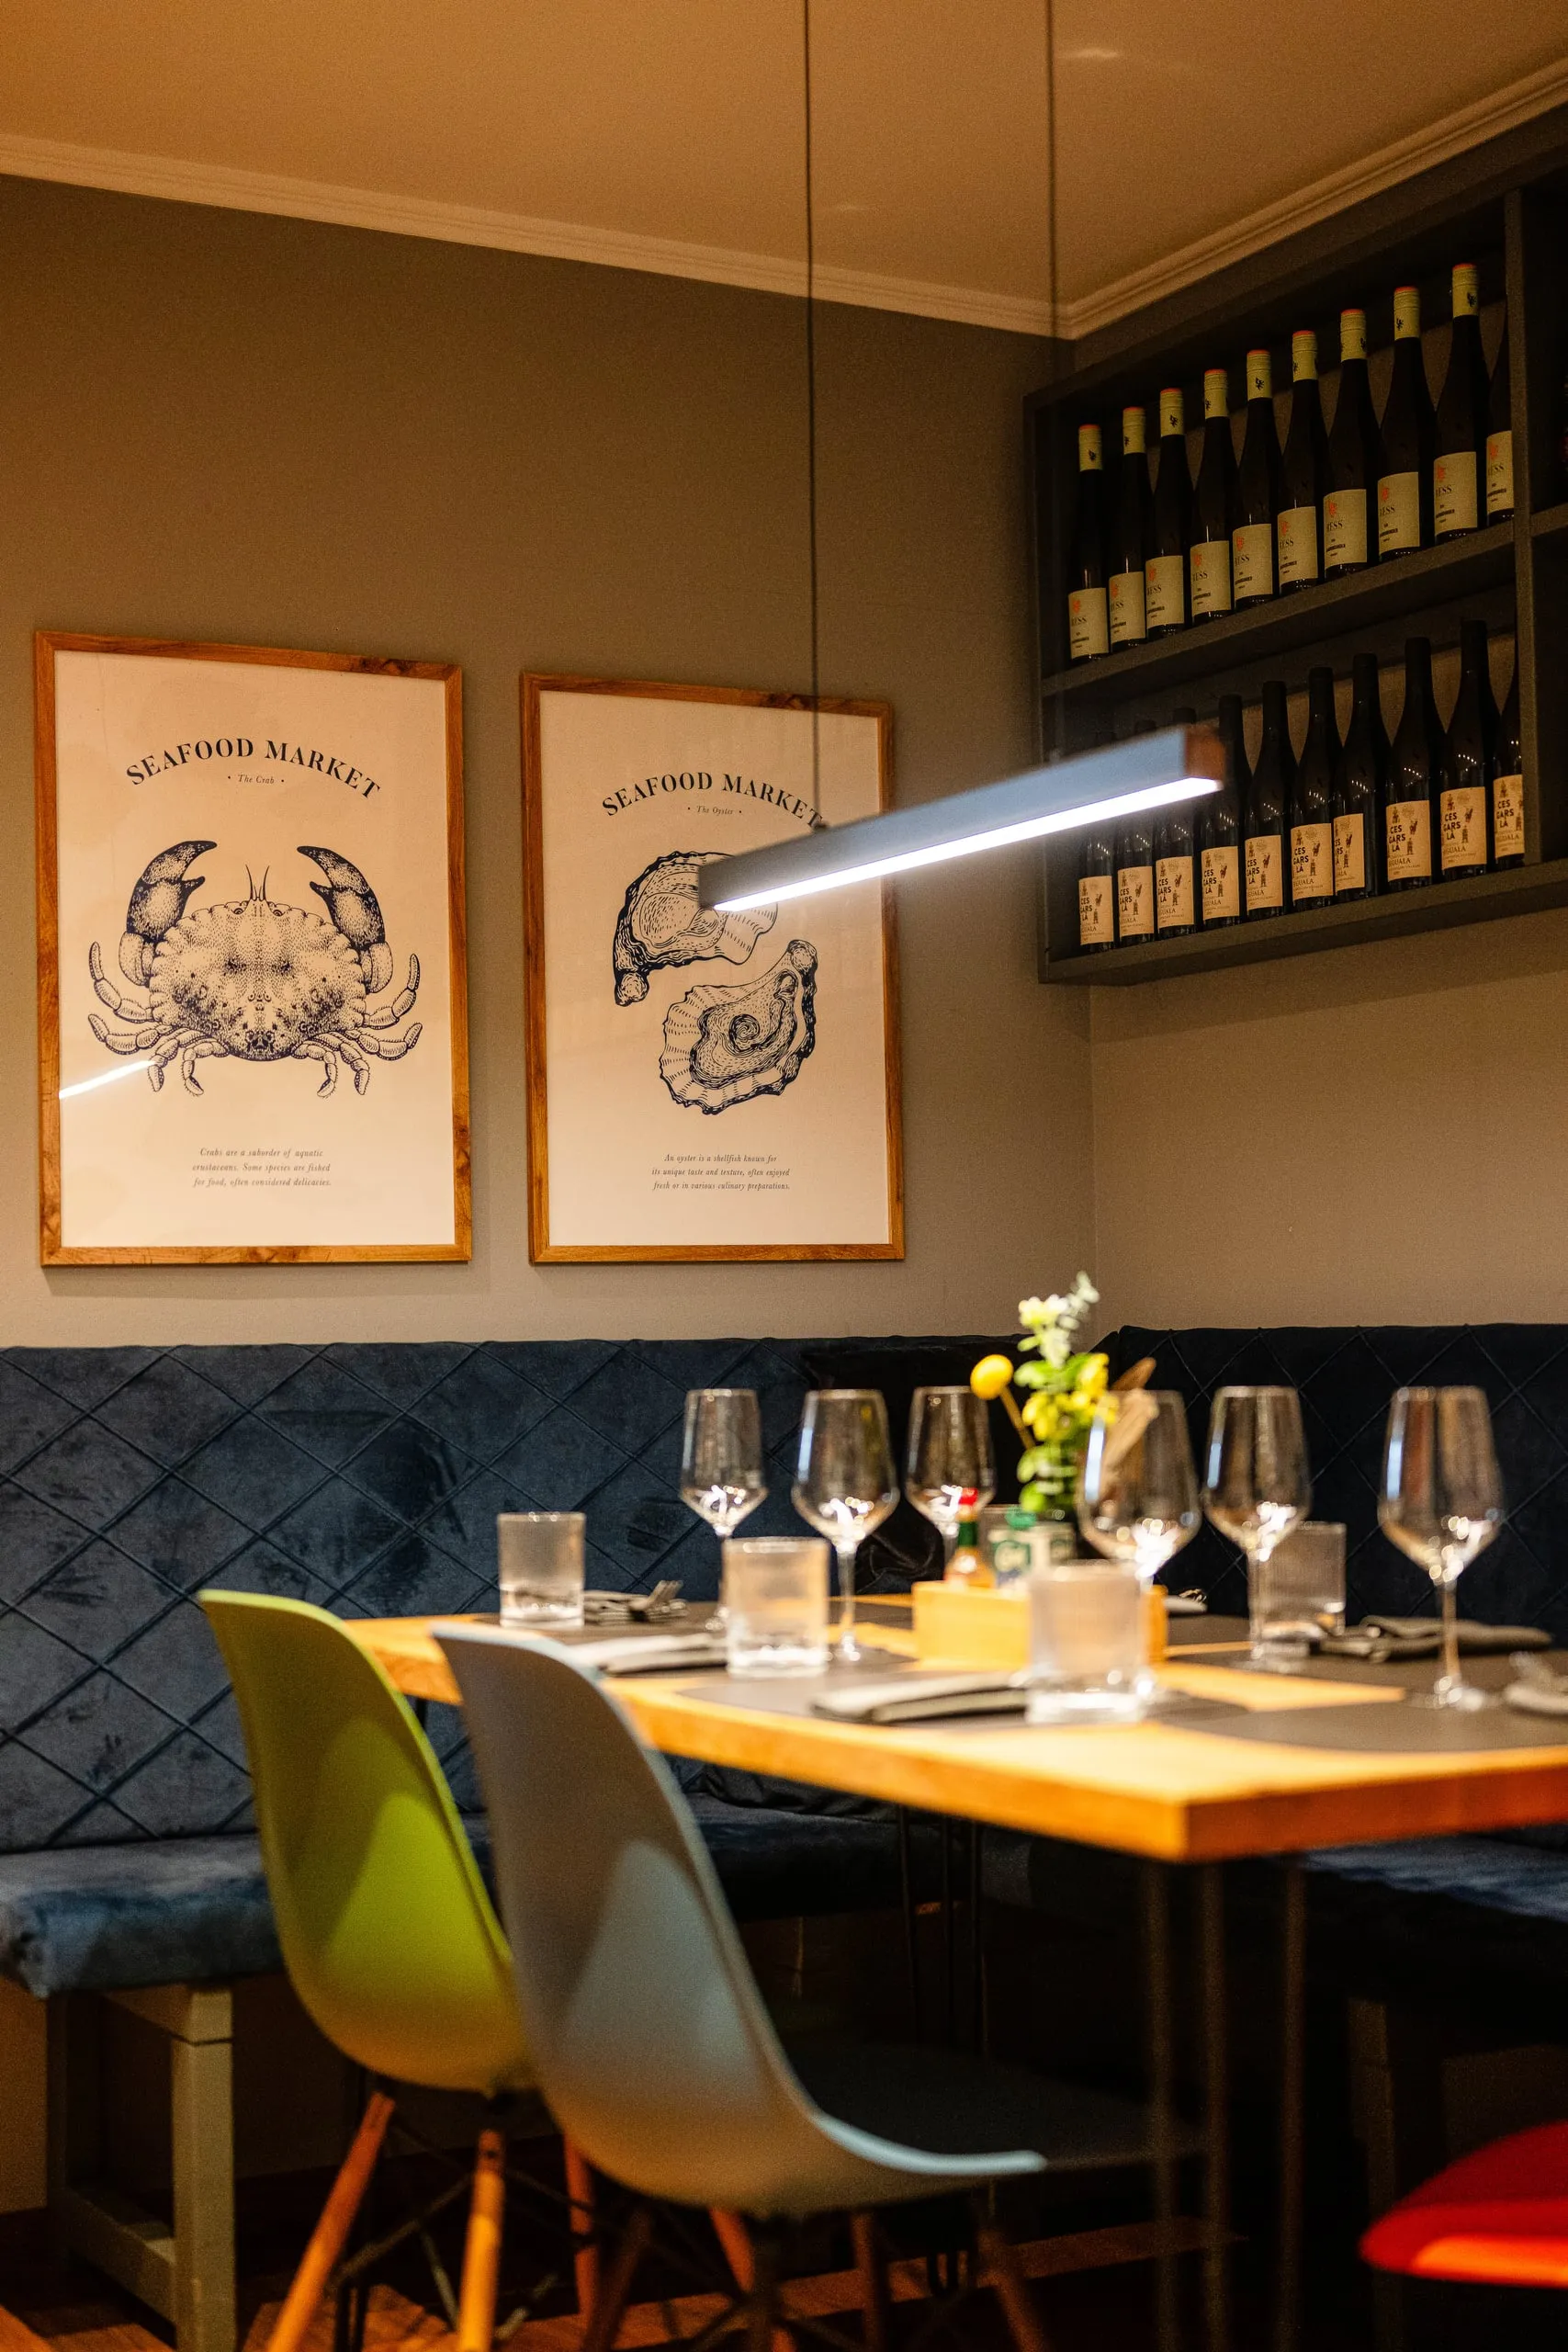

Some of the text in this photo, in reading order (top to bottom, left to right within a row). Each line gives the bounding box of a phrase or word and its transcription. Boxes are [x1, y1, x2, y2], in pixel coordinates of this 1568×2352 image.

[126, 739, 380, 798] SEAFOOD MARKET
[238, 774, 275, 785] The Crab
[603, 772, 823, 828] SEAFOOD MARKET
[1498, 799, 1510, 808] CES
[712, 807, 733, 816] Oyster
[1445, 812, 1457, 821] CES
[1496, 808, 1514, 820] GARS
[1391, 825, 1403, 834] CES
[1444, 821, 1461, 831] GARS
[1389, 833, 1406, 844] GARS
[1294, 847, 1305, 855] CES
[284, 1148, 290, 1159] of
[295, 1149, 323, 1158] aquatic
[677, 1155, 695, 1163] oyster
[714, 1154, 740, 1163] shellfish
[767, 1155, 777, 1164] for
[243, 1163, 262, 1171] Some
[265, 1164, 290, 1173] species
[308, 1163, 330, 1172] fished
[663, 1169, 685, 1177] unique
[766, 1169, 790, 1177] enjoyed
[194, 1179, 204, 1187] for
[231, 1178, 248, 1187] often
[252, 1178, 290, 1186] considered
[653, 1182, 670, 1191] fresh
[718, 1182, 745, 1191] culinary
